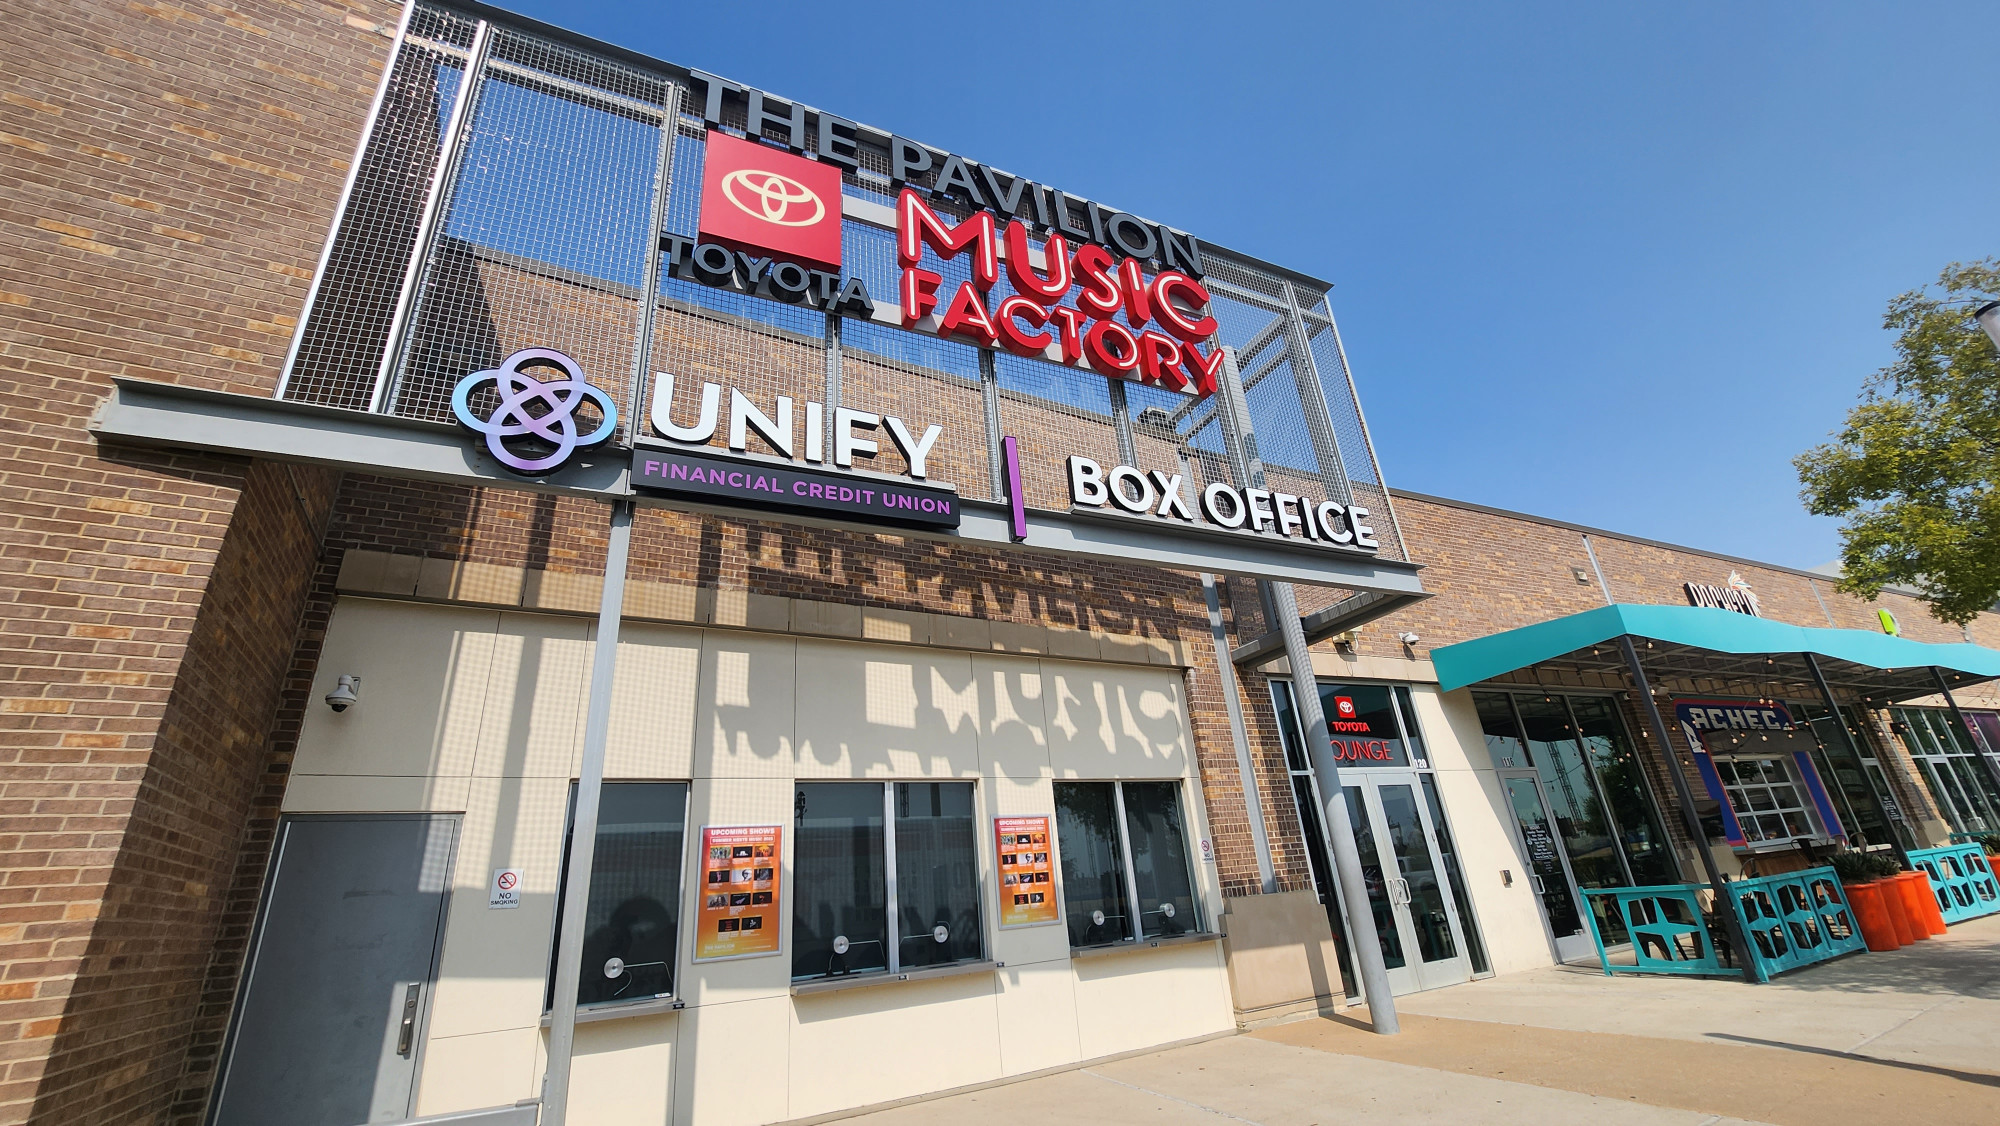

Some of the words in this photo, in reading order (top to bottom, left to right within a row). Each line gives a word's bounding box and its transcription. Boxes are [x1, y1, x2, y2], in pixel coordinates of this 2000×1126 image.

[690, 67, 859, 173] THE
[889, 133, 1205, 281] PAVILION
[660, 231, 874, 319] TOYOTA
[896, 187, 1218, 344] MUSIC
[899, 266, 1224, 399] FACTORY
[650, 371, 944, 479] UNIFY
[644, 460, 784, 494] FINANCIAL
[792, 480, 875, 505] CREDIT
[882, 492, 951, 515] UNION
[1067, 455, 1194, 521] BOX
[1200, 481, 1380, 549] OFFICE
[1330, 740, 1394, 760] OUNGE
[1332, 721, 1371, 732] TOYOTA
[1414, 758, 1427, 768] 120
